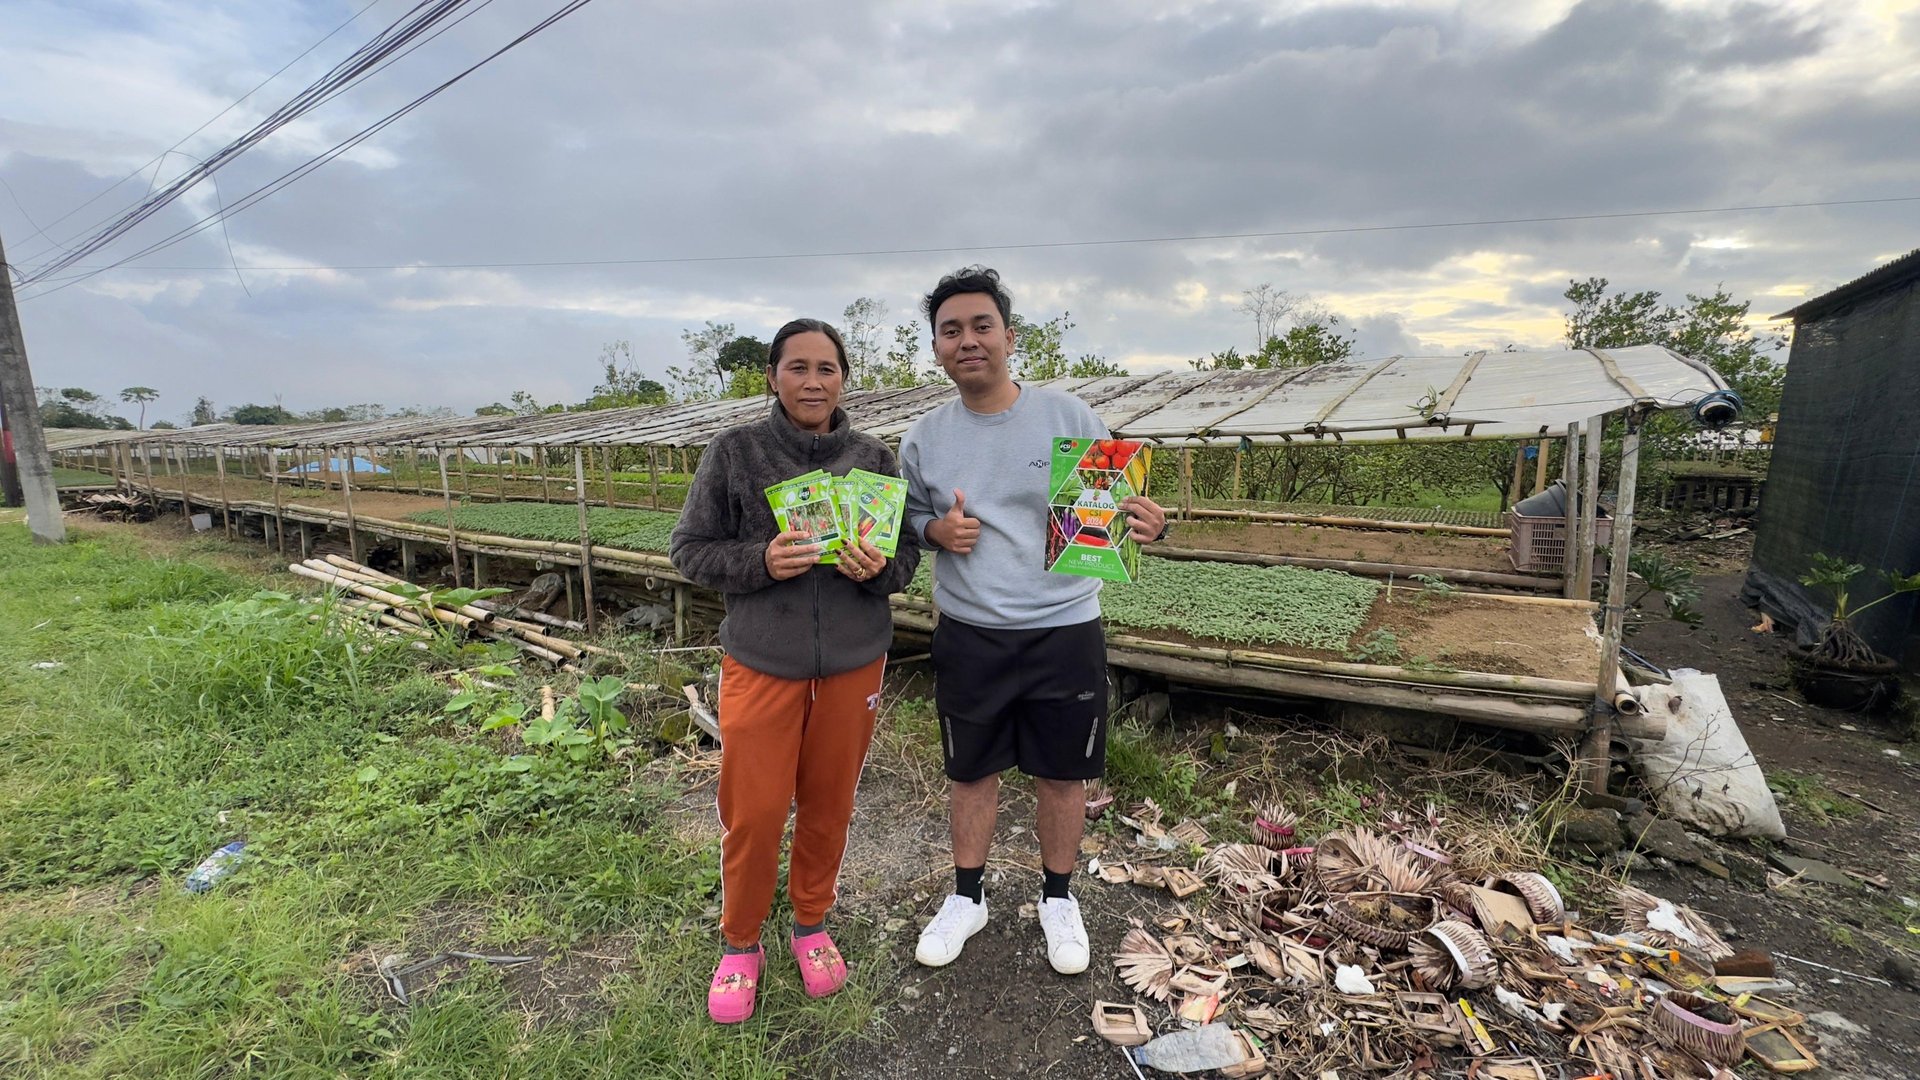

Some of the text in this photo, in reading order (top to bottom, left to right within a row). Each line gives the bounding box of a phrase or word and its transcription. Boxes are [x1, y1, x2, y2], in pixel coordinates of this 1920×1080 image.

[1077, 501, 1115, 509] KATALOG
[1086, 517, 1103, 525] 2024
[1081, 554, 1102, 562] BEST
[1085, 561, 1115, 569] PRODUCT
